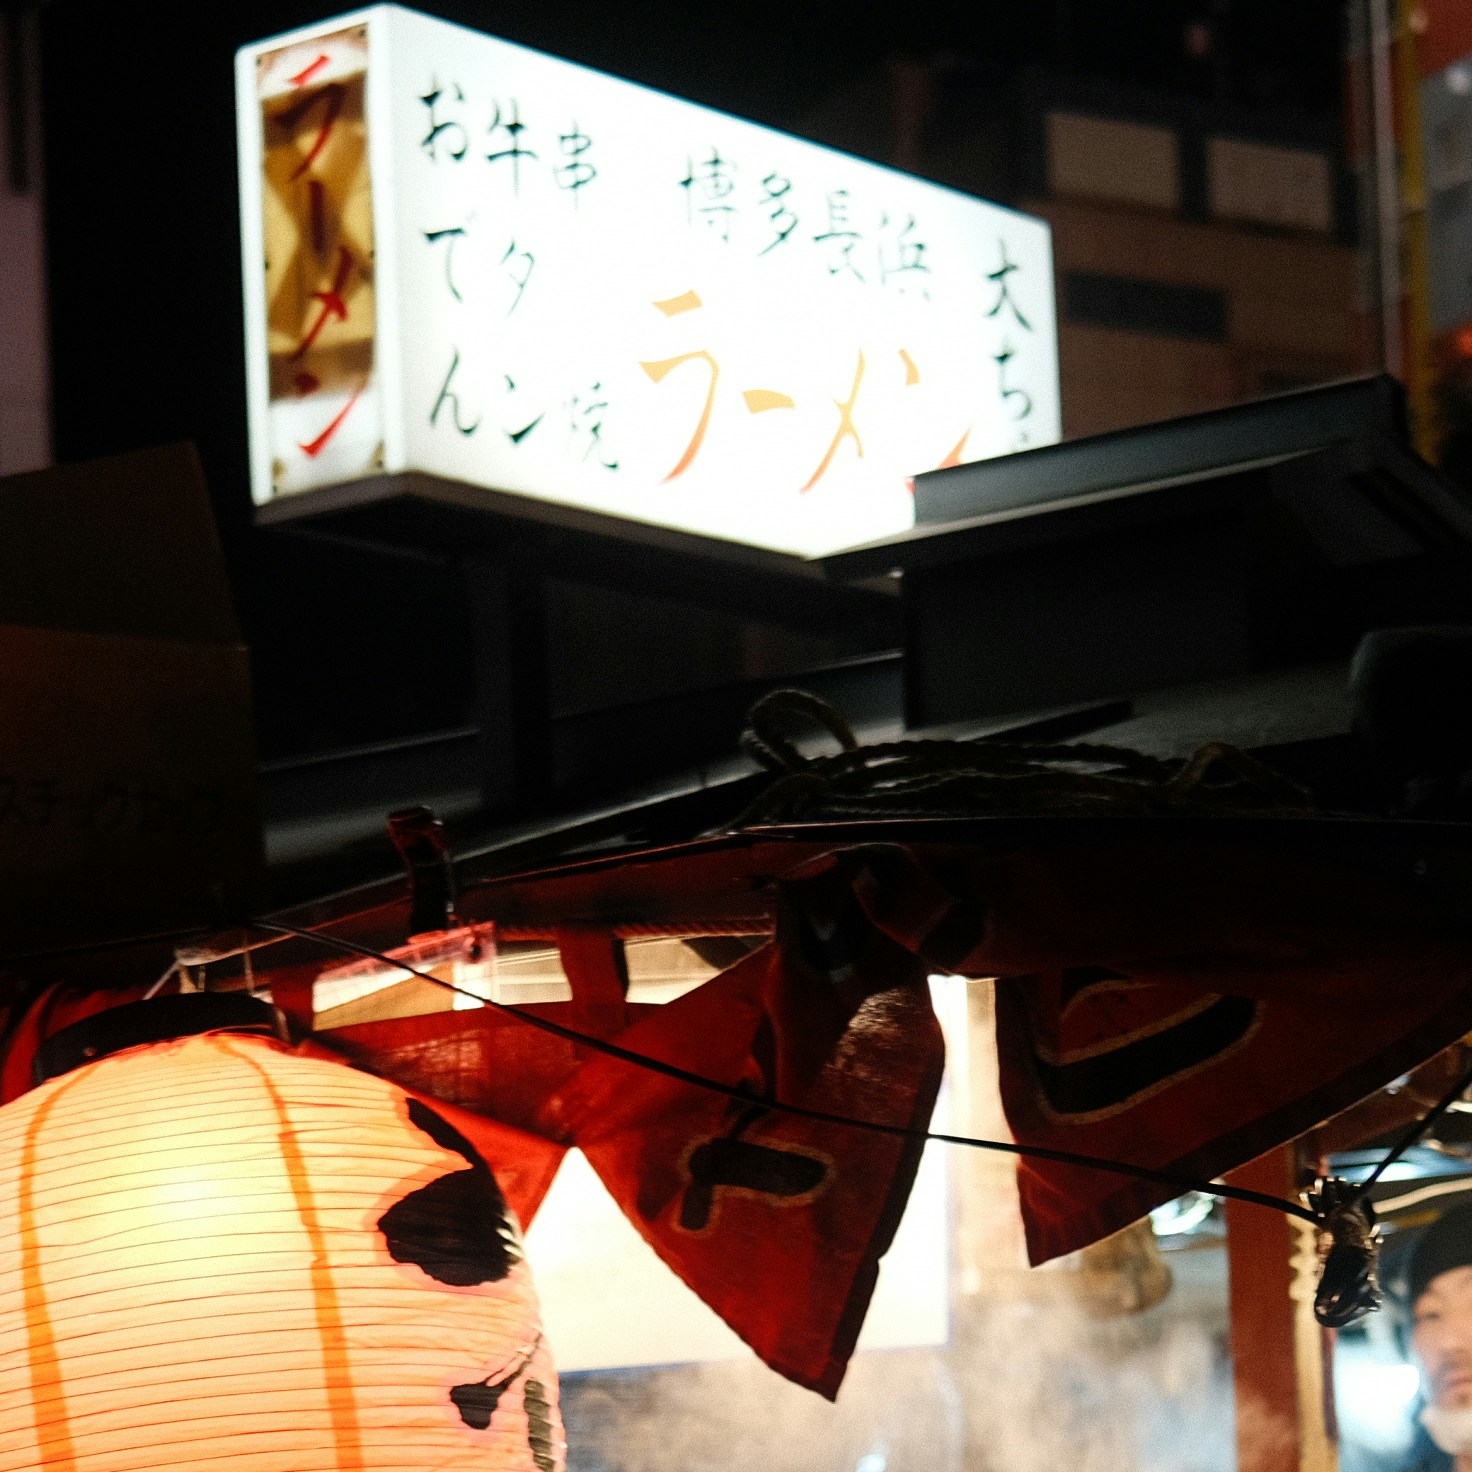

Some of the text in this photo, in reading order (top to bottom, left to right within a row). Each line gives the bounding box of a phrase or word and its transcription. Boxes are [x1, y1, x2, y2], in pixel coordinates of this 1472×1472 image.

[271, 54, 367, 459] ラーメン
[417, 74, 483, 437] おでん
[485, 99, 548, 446] 牛タン
[678, 147, 932, 302] 博多長浜
[983, 240, 1033, 444] 大ち
